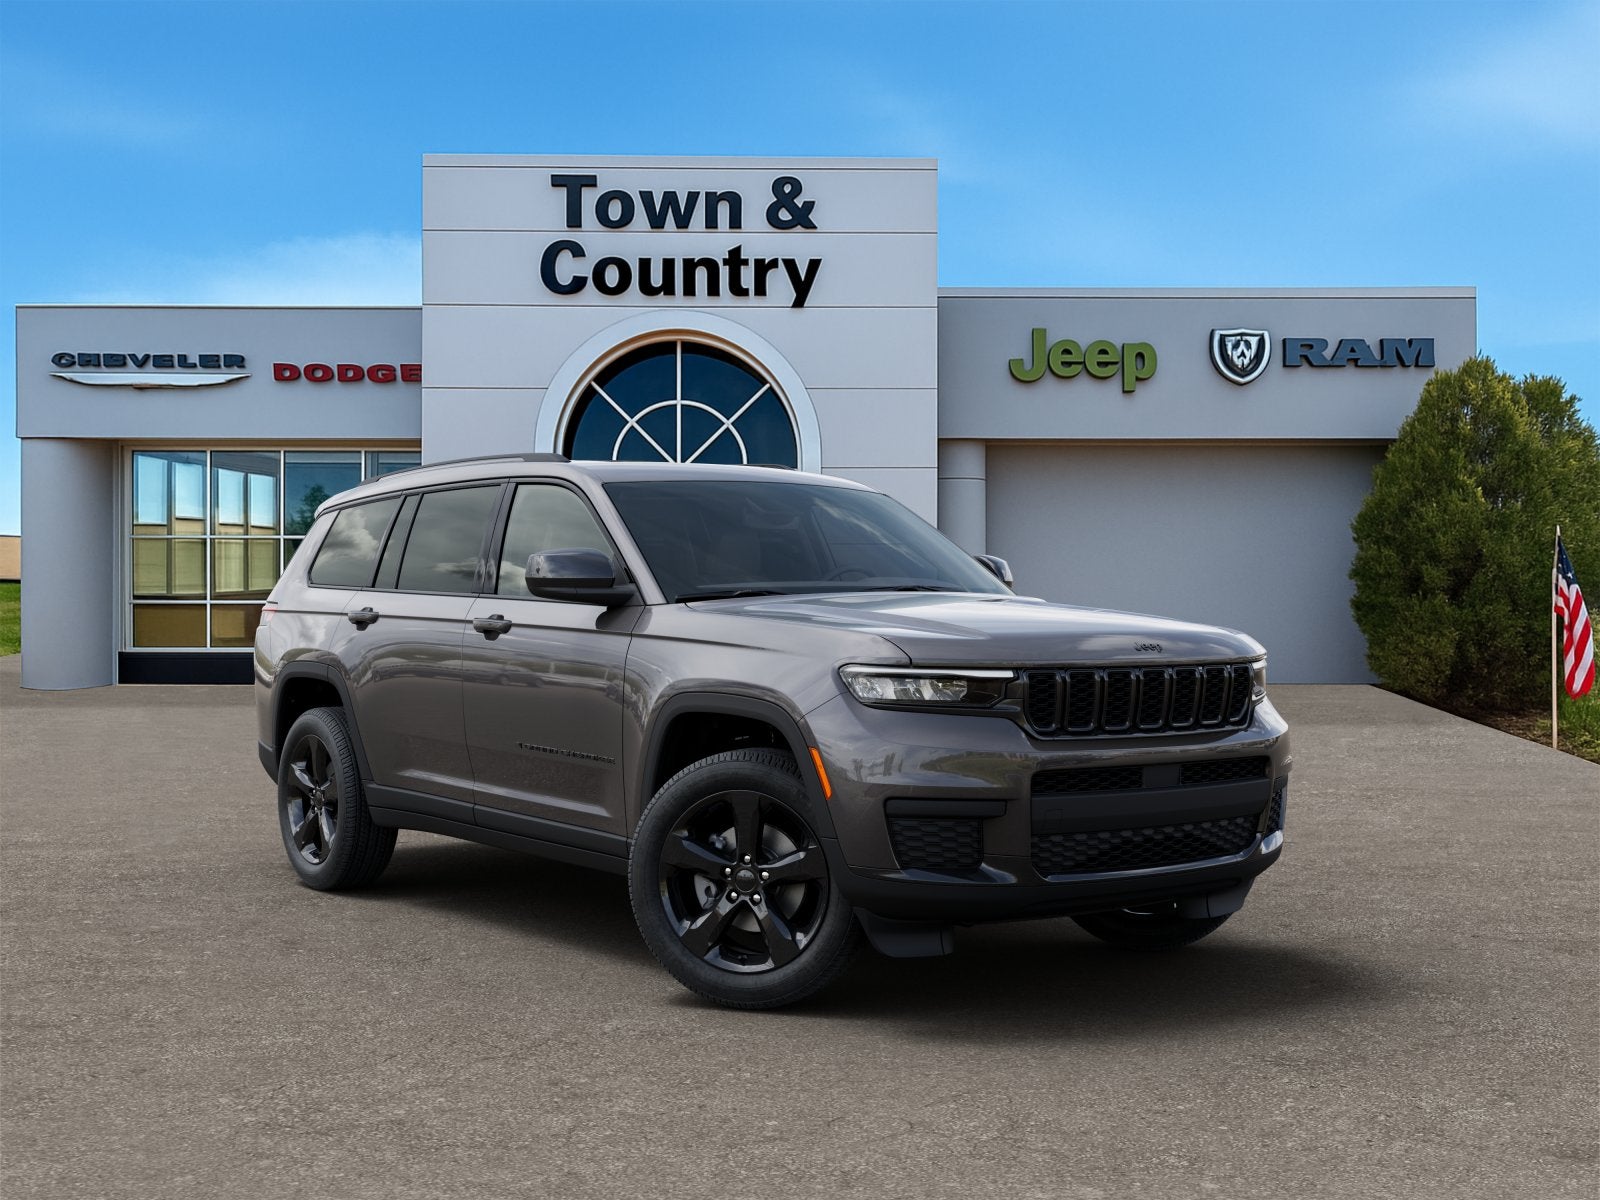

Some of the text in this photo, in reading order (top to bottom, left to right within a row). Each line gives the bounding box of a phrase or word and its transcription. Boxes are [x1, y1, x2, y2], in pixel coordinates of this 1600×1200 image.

[551, 174, 818, 230] Town &
[540, 239, 822, 308] Country
[273, 363, 422, 383] DODGE
[1009, 328, 1156, 393] Jeep
[1283, 337, 1435, 368] RAM
[1134, 641, 1163, 655] Jeep
